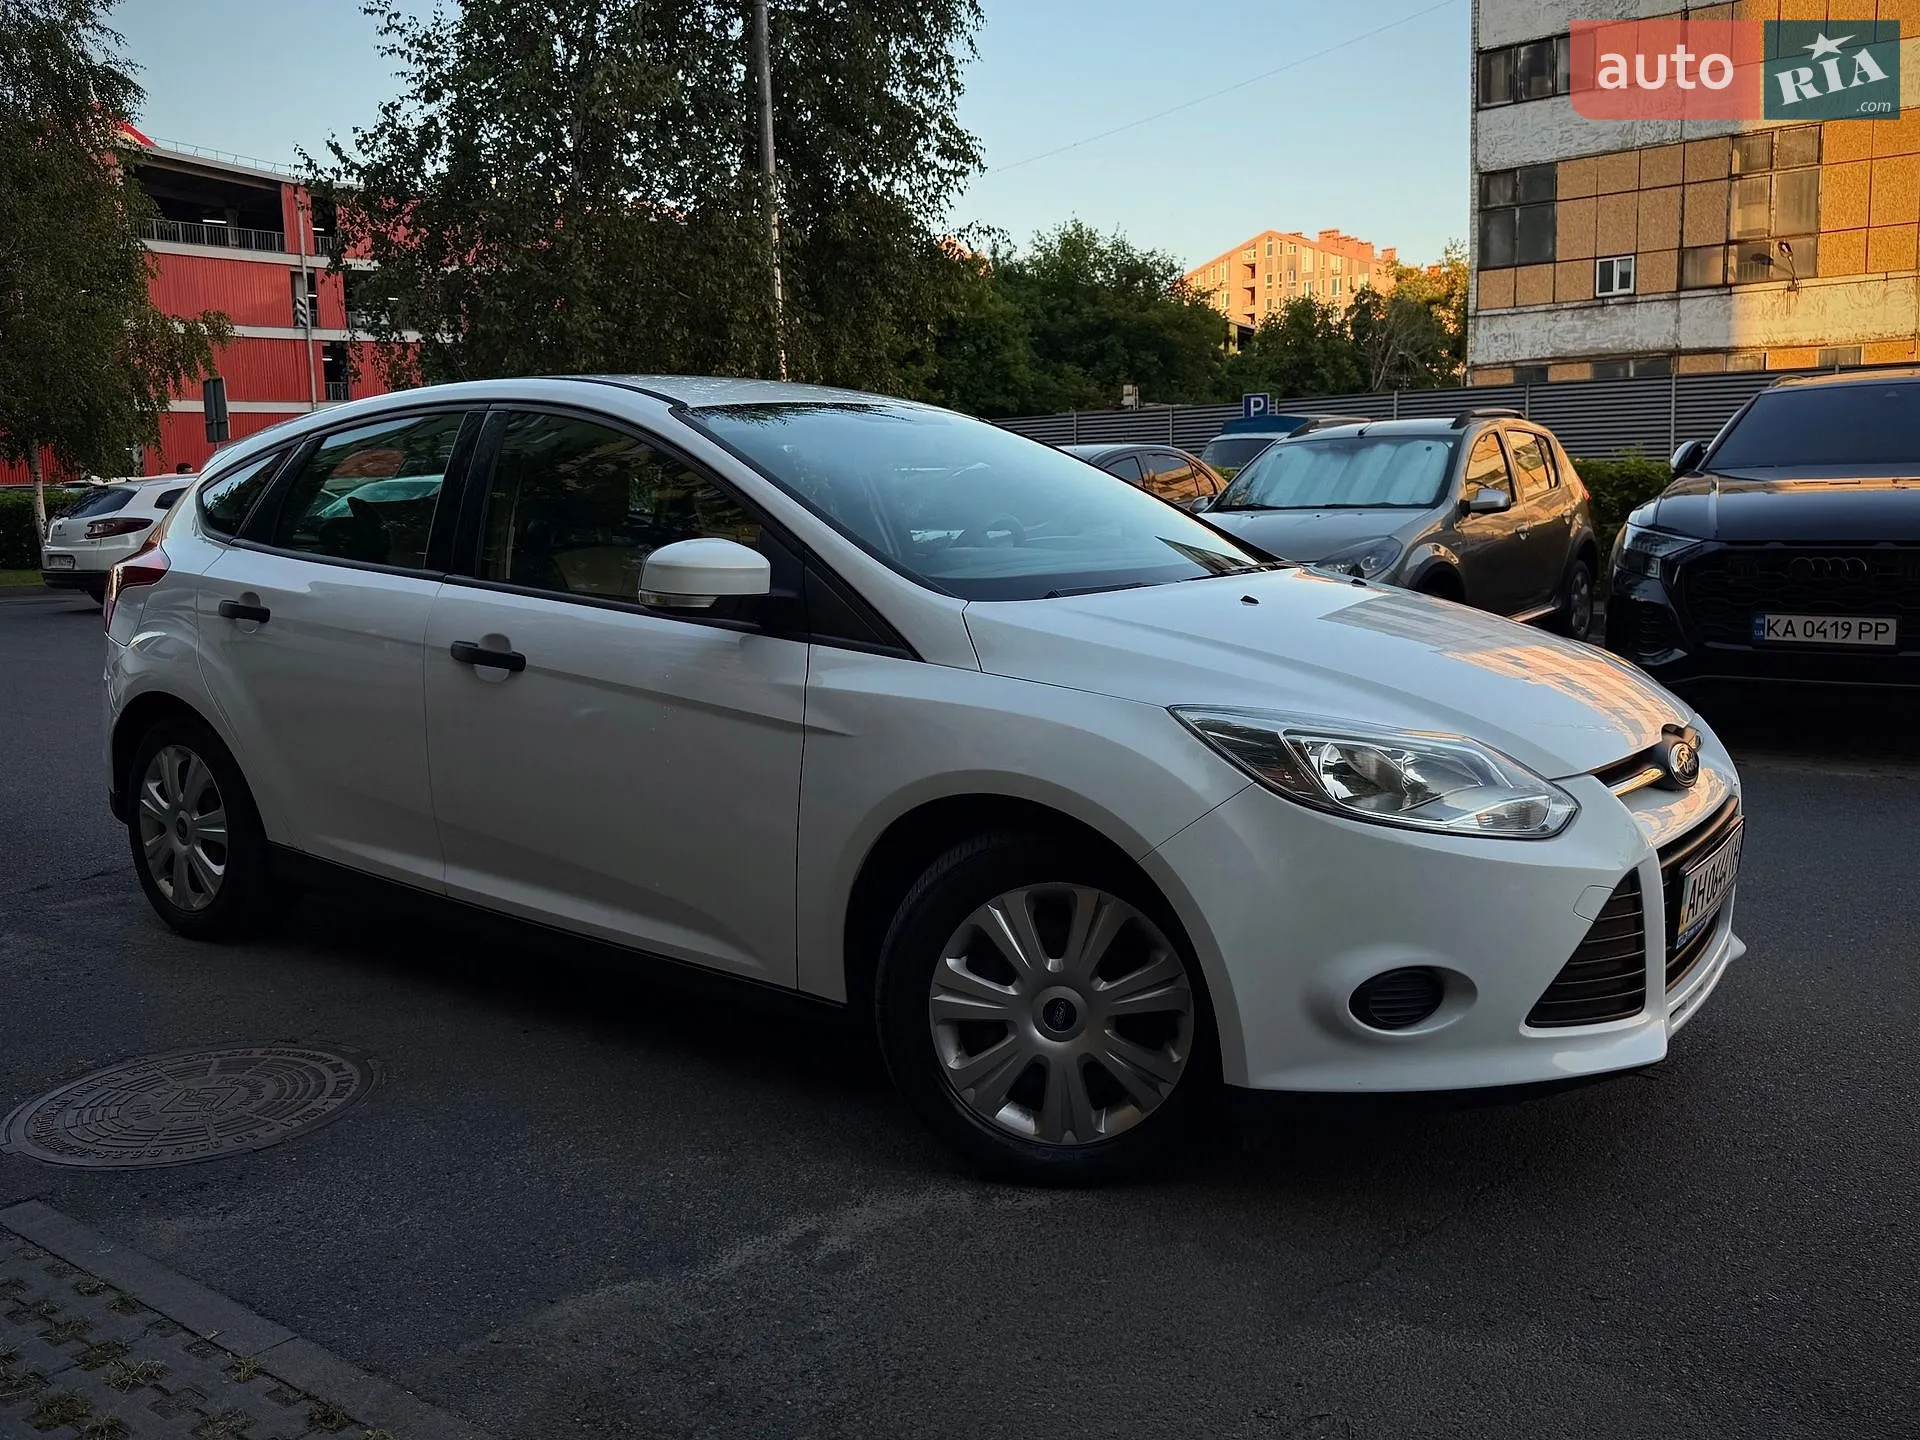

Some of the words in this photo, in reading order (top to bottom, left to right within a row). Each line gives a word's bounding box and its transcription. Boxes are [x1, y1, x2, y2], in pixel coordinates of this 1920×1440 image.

[1250, 397, 1264, 417] P
[1767, 618, 1796, 638] KA
[1803, 620, 1852, 640] 0419
[1858, 621, 1890, 641] PP
